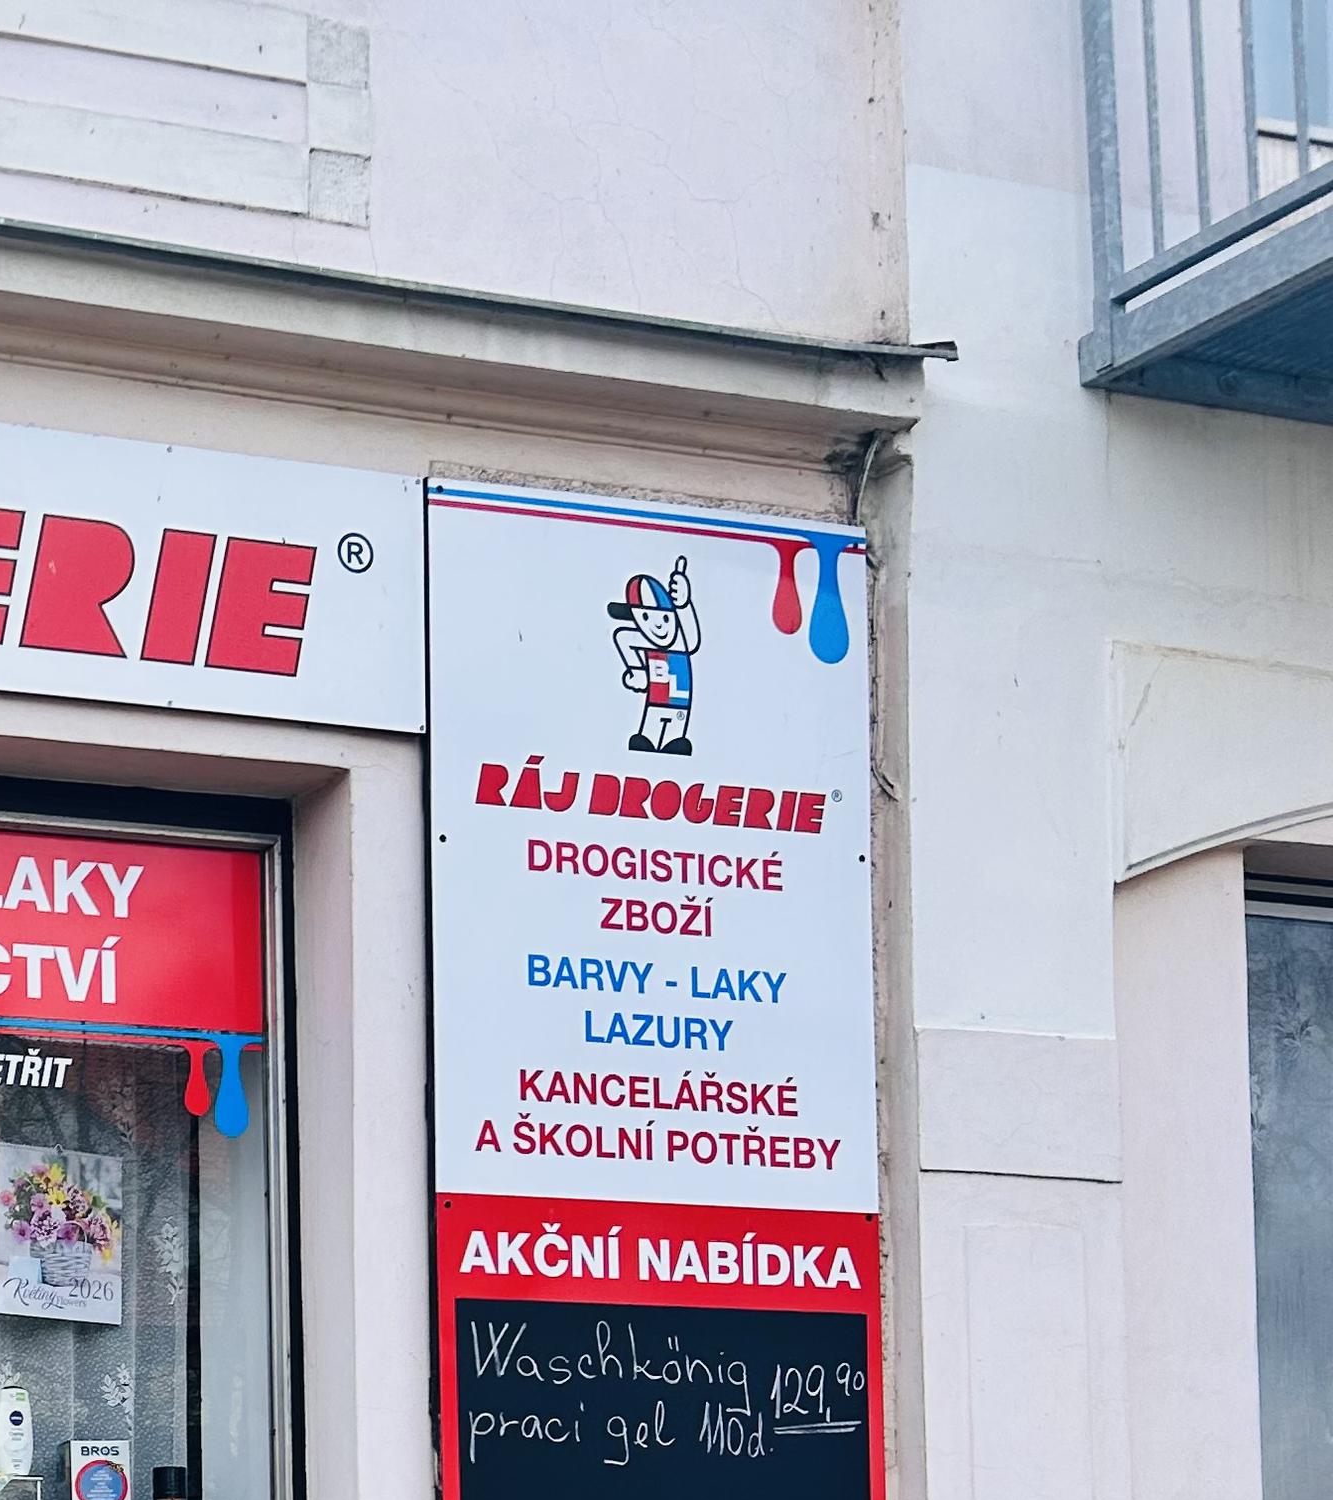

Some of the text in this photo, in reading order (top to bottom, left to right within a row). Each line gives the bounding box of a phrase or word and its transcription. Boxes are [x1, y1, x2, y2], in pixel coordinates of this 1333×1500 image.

[475, 755, 826, 833] RÁJ DROGERIE
[527, 840, 783, 892] DROGISTICKÉ
[601, 895, 714, 937] ZBOŽÍ
[527, 954, 653, 994] BARVY
[690, 967, 787, 1003] LAKY
[585, 1011, 733, 1051] LAZURY
[519, 1069, 799, 1118] KANCELÁŘSKÉ
[475, 1113, 841, 1170] A ŠKOLNÍ POTŘEBY
[459, 1222, 861, 1289] AKČNÍ NABÍDKA
[69, 1278, 114, 1301] 2026
[470, 1320, 751, 1415] Waschkönig
[81, 1446, 119, 1456] BROS
[603, 1401, 675, 1465] gel
